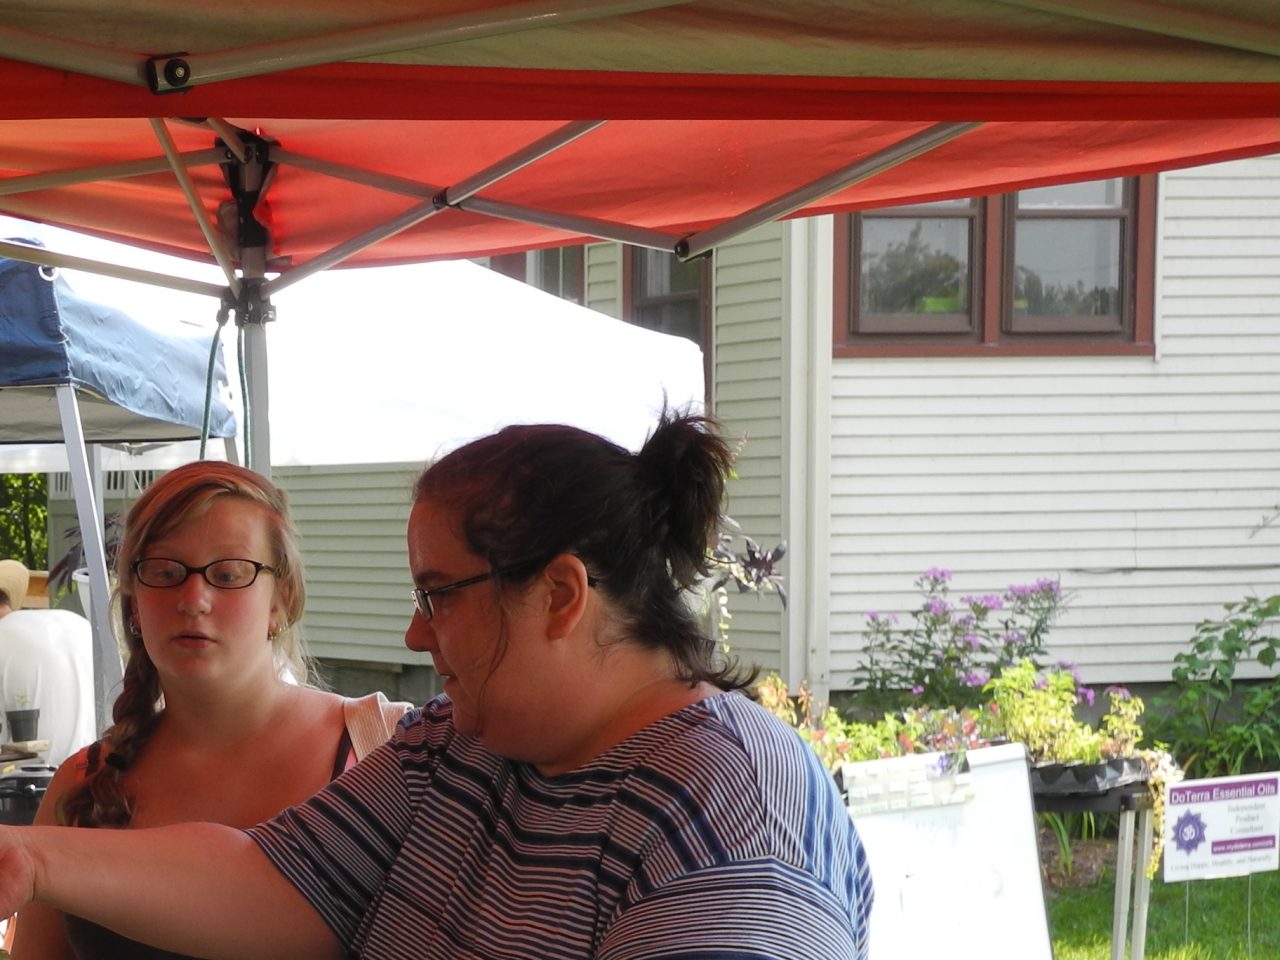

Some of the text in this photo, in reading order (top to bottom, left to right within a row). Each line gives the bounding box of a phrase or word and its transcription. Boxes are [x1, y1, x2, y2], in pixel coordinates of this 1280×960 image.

[1171, 783, 1276, 804] DoTerra Essential Oils
